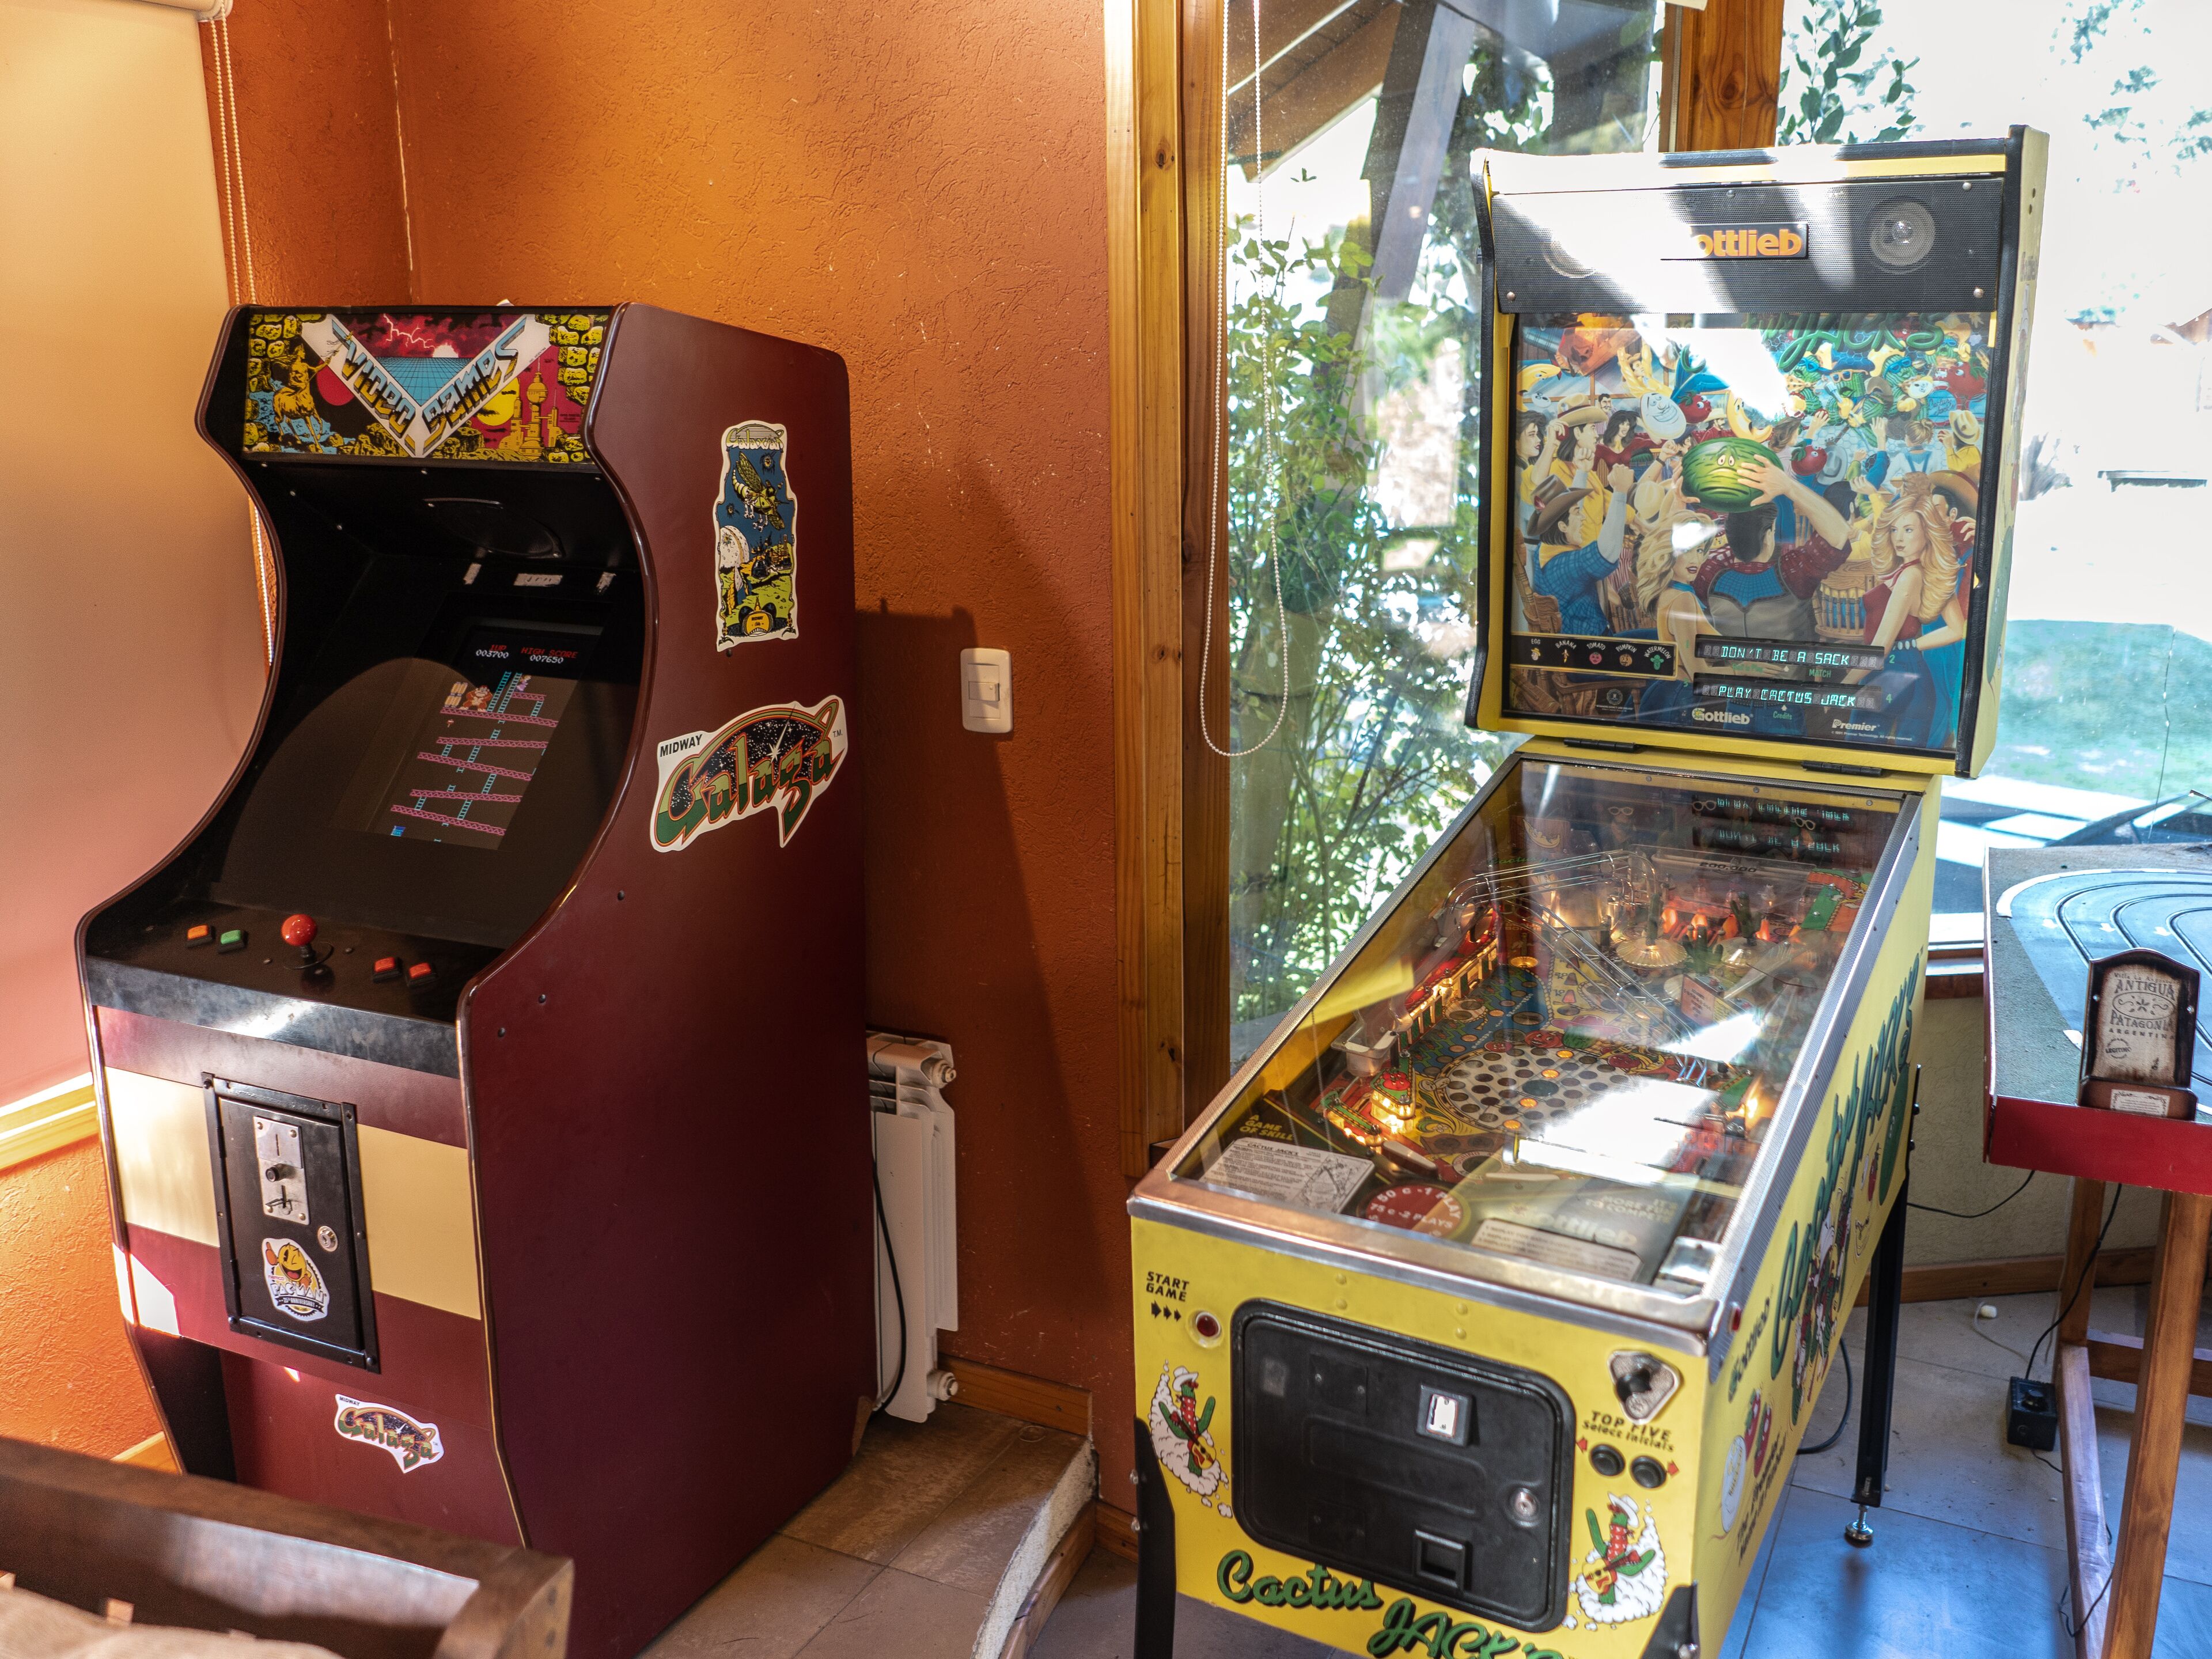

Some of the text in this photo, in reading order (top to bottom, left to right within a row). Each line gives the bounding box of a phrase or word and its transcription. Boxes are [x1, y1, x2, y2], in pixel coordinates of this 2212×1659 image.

[1691, 229, 1802, 257] ottlieb
[475, 649, 509, 658] 003700
[521, 646, 578, 658] HIGH SCORE
[529, 654, 564, 664] 007650
[1555, 639, 1577, 650] BANANA
[1586, 642, 1606, 650] TOMATO
[1615, 643, 1638, 654] PUMPKIN
[1643, 645, 1672, 660] WATERMELON
[1721, 645, 1850, 666] DON'T BE A SACK
[1888, 654, 1896, 664] 2
[1809, 668, 1832, 678] MATCH
[1718, 685, 1857, 707] PLAY CACTUS JACK
[1885, 694, 1893, 703] 4
[1692, 708, 1751, 725] Gottlieb
[1772, 711, 1793, 720] Credits
[832, 729, 844, 738] T.M.
[1831, 719, 1877, 732] Premier
[659, 733, 703, 757] MIDWAY
[2113, 979, 2176, 1001] ANTIGUA
[2108, 1028, 2175, 1040] ARGENTINA
[1239, 1126, 1294, 1141] OF SKILL
[1244, 1120, 1283, 1131] GAME
[1247, 1142, 1274, 1152] CACTUS
[1376, 1190, 1397, 1203] 50
[1435, 1191, 1462, 1219] PLAY
[1370, 1202, 1386, 1213] 75
[1412, 1213, 1454, 1229] PLAYS
[1533, 1213, 1638, 1245] ottlieb
[1146, 1270, 1190, 1291] START
[1145, 1282, 1187, 1303] GAME
[339, 1396, 360, 1407] MIDWAY
[1591, 1410, 1672, 1441] TOP FIVE
[1582, 1420, 1675, 1452] Select Initials
[1217, 1550, 1384, 1610] Cactus
[1366, 1597, 1563, 1659] JACK'
